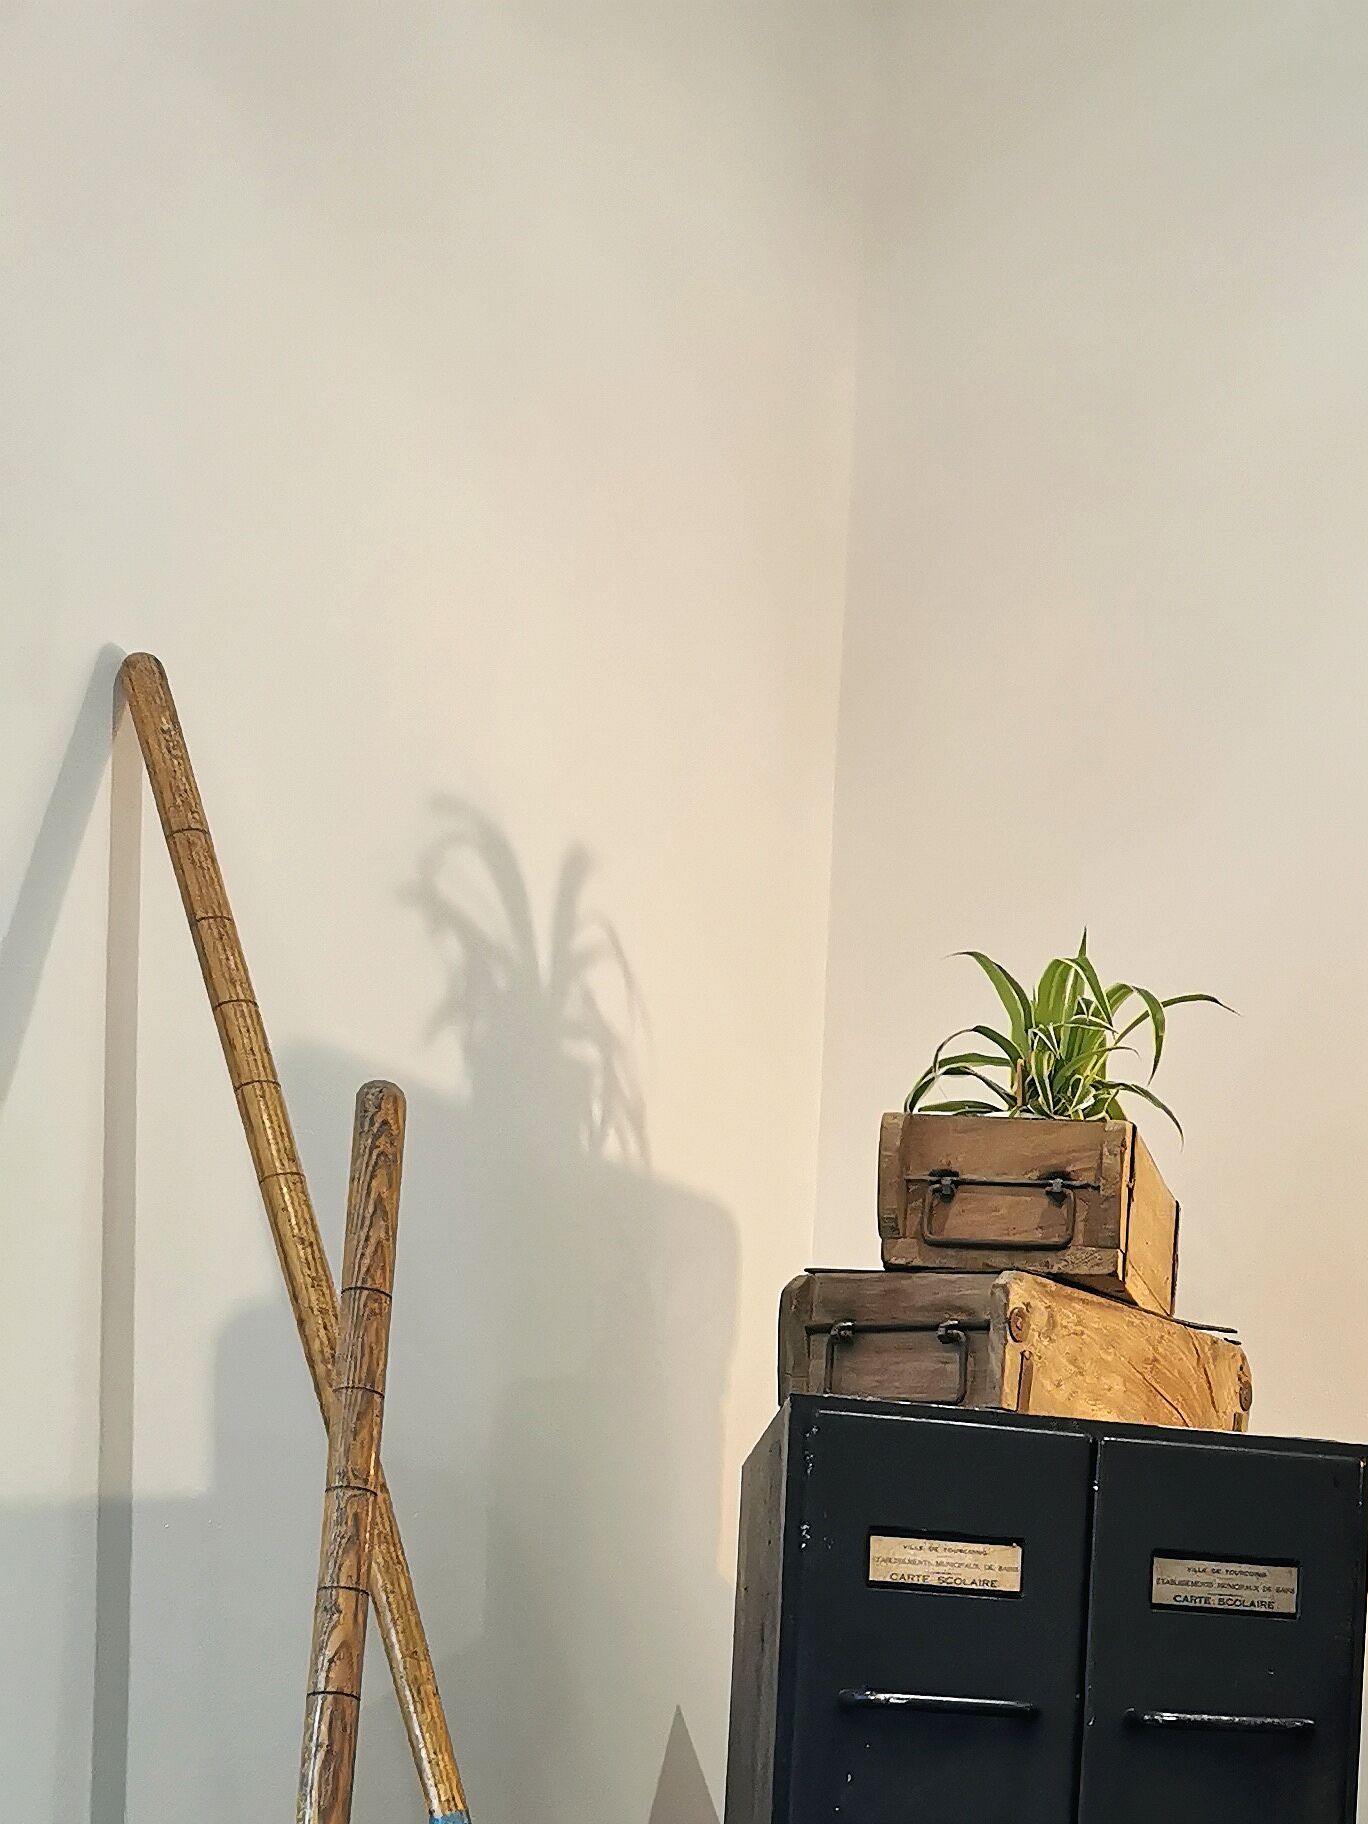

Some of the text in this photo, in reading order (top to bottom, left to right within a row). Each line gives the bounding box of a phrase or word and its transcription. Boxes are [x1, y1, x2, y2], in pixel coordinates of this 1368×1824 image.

[890, 1572, 998, 1588] CARTE SCOLAIRE
[1173, 1594, 1275, 1610] CARTE SCOLAIRE
